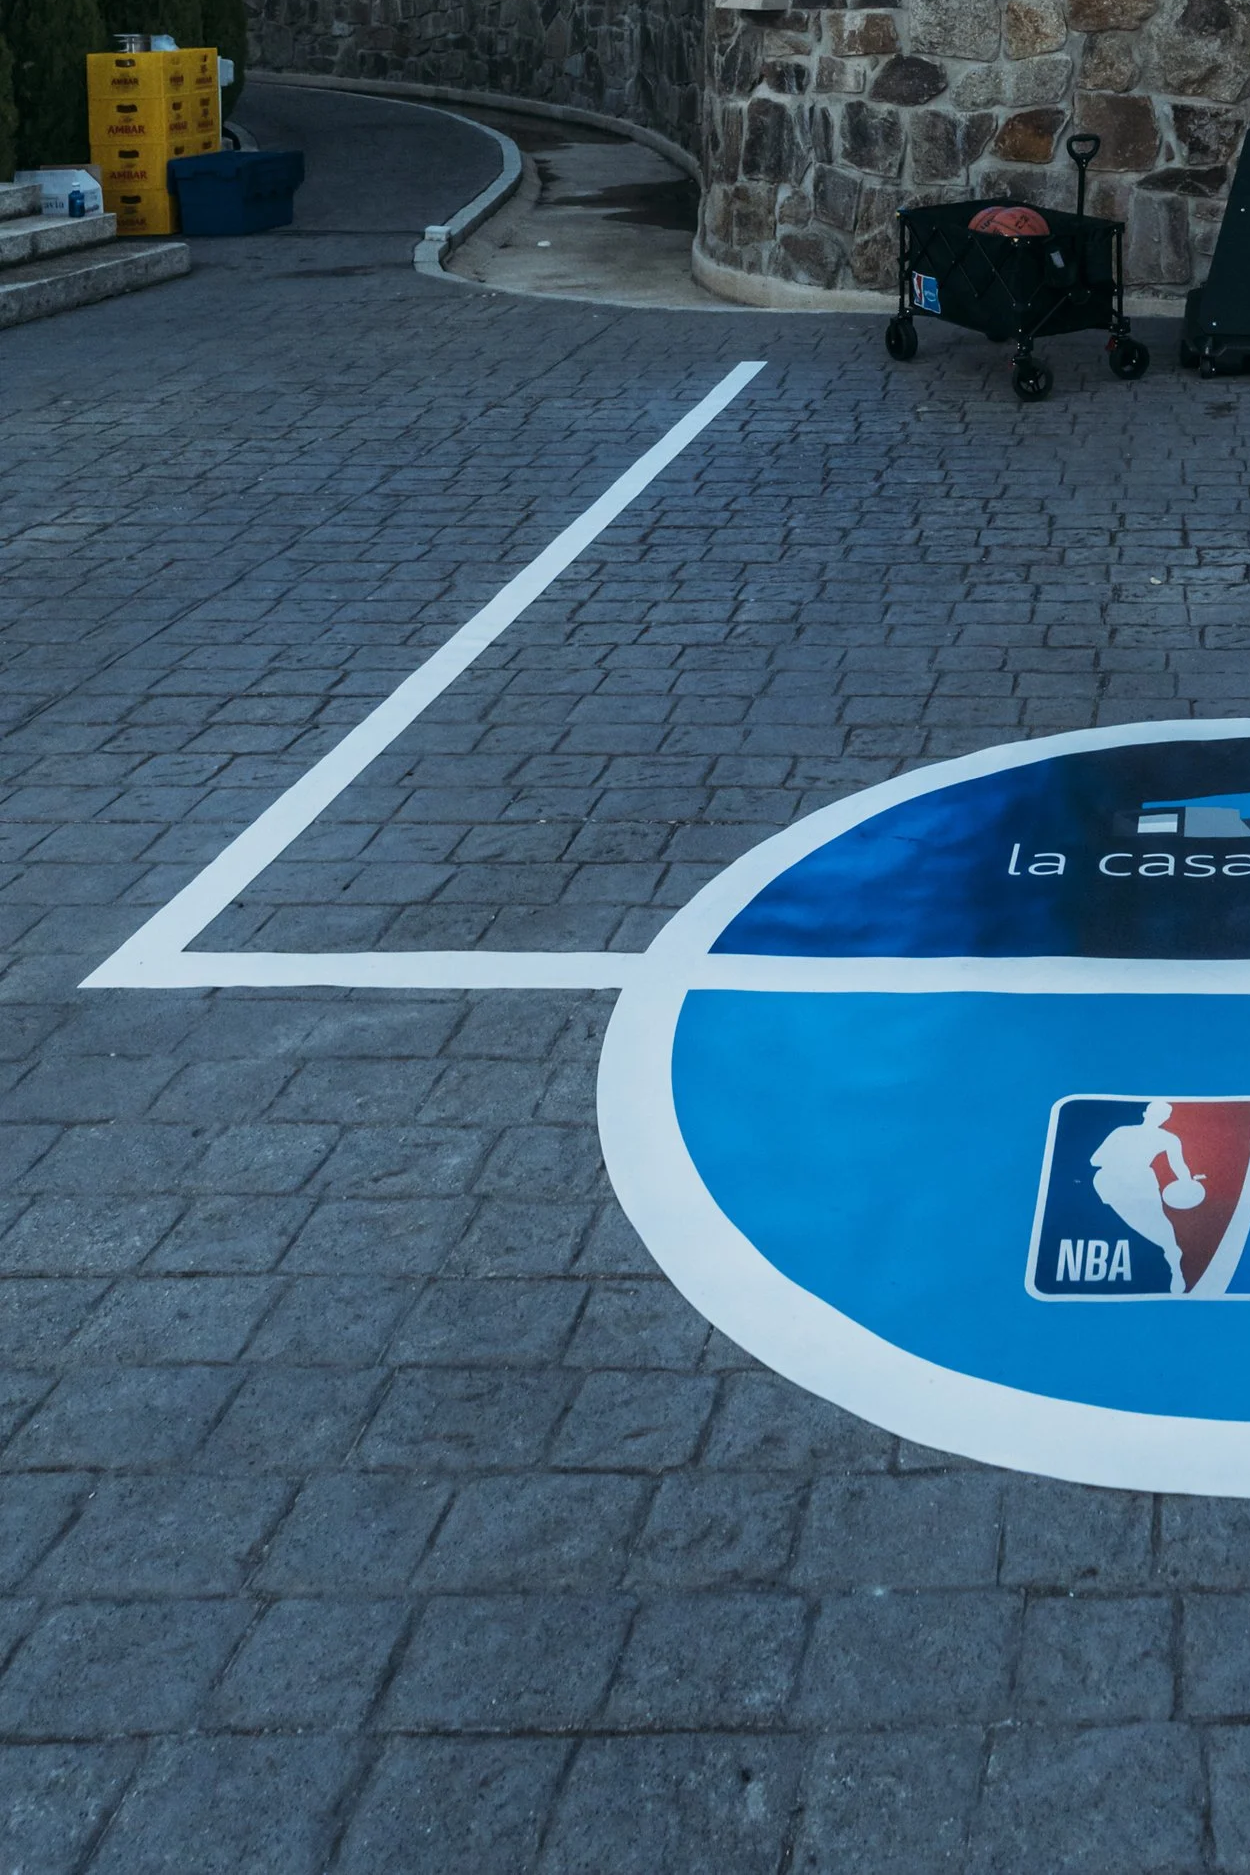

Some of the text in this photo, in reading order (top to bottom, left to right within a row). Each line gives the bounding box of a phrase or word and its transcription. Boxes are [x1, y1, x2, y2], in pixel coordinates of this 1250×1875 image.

[111, 77, 139, 86] AMBAR
[107, 125, 145, 135] AMBAR
[110, 170, 148, 180] AMBAR
[1007, 842, 1067, 877] la
[1055, 1238, 1132, 1282] NBA
